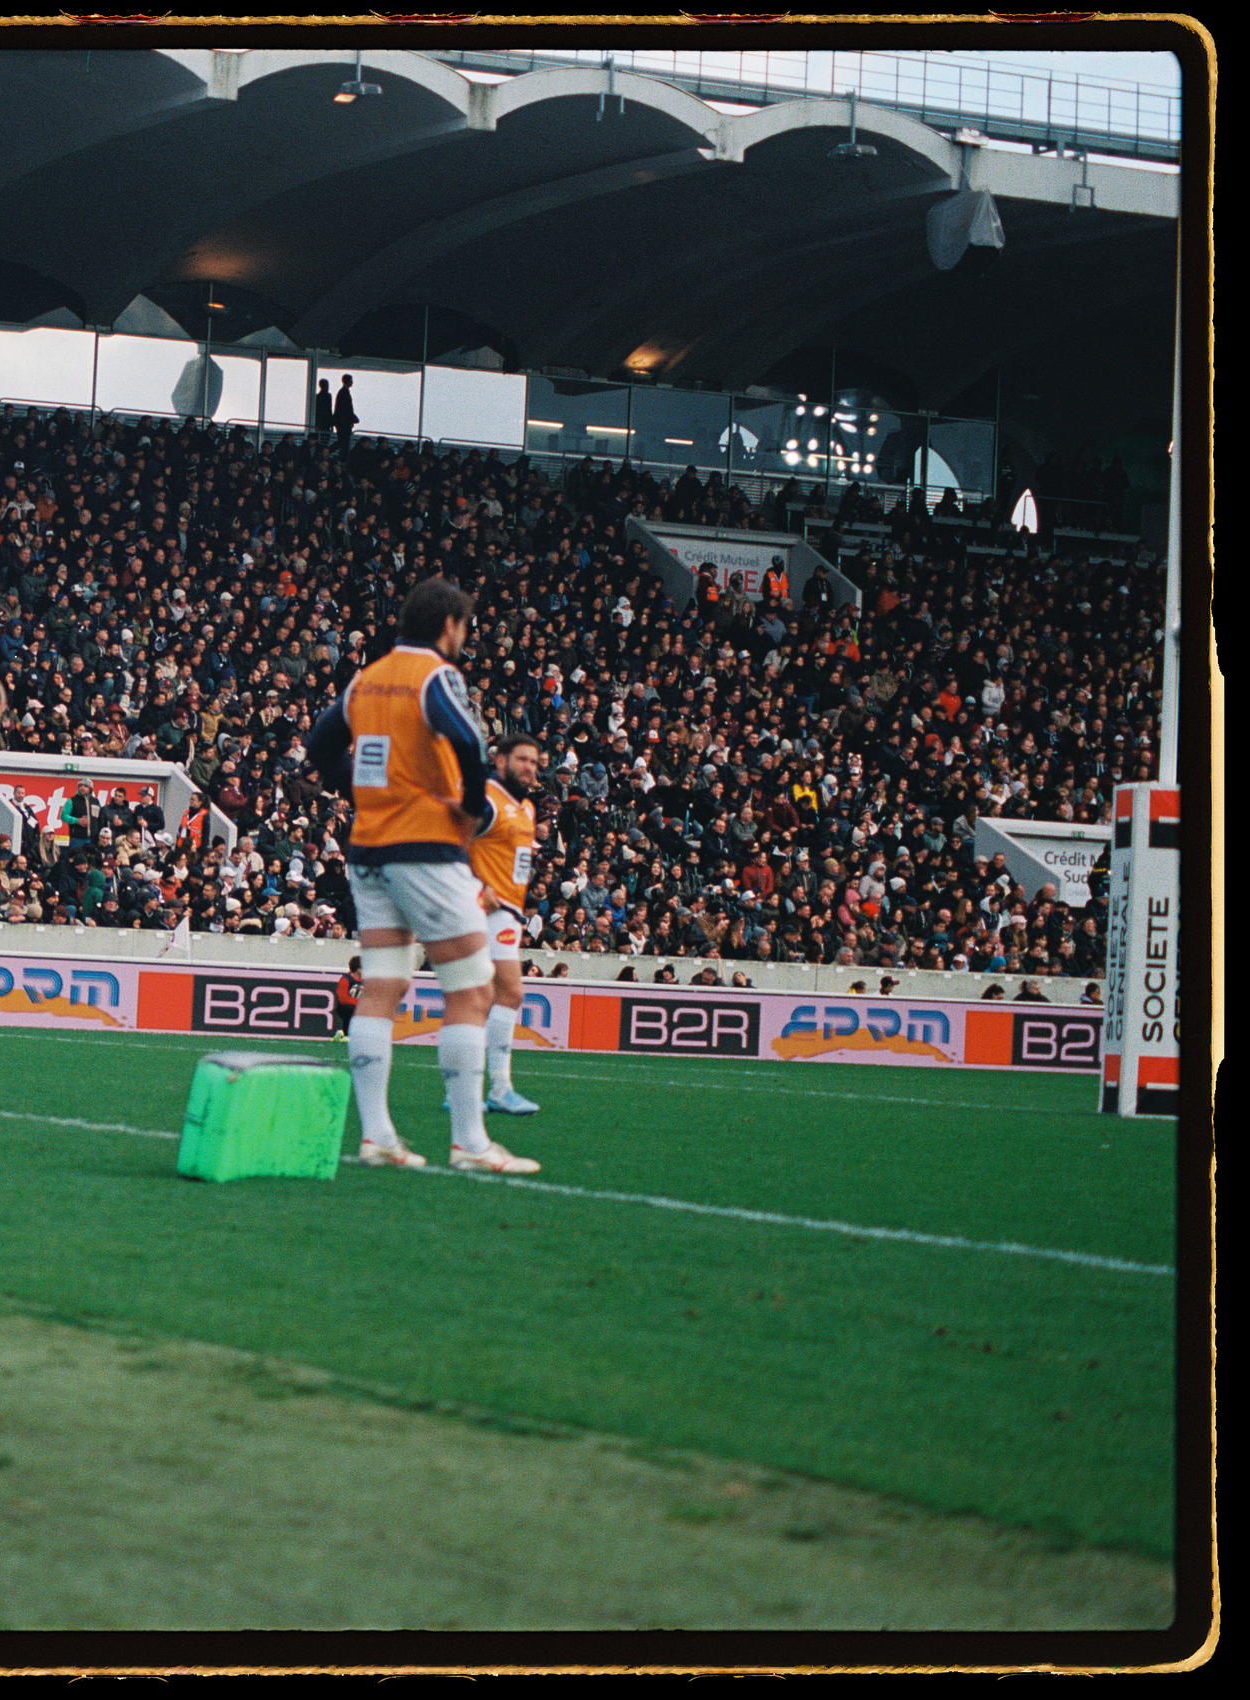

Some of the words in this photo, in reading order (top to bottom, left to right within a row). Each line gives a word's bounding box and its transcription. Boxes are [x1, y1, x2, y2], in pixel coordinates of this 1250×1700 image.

[1044, 851, 1086, 867] Crédit
[1142, 897, 1169, 1043] SOCIETE
[204, 983, 334, 1030] B2R
[630, 1005, 748, 1049] B2R
[1022, 1021, 1103, 1062] B2
